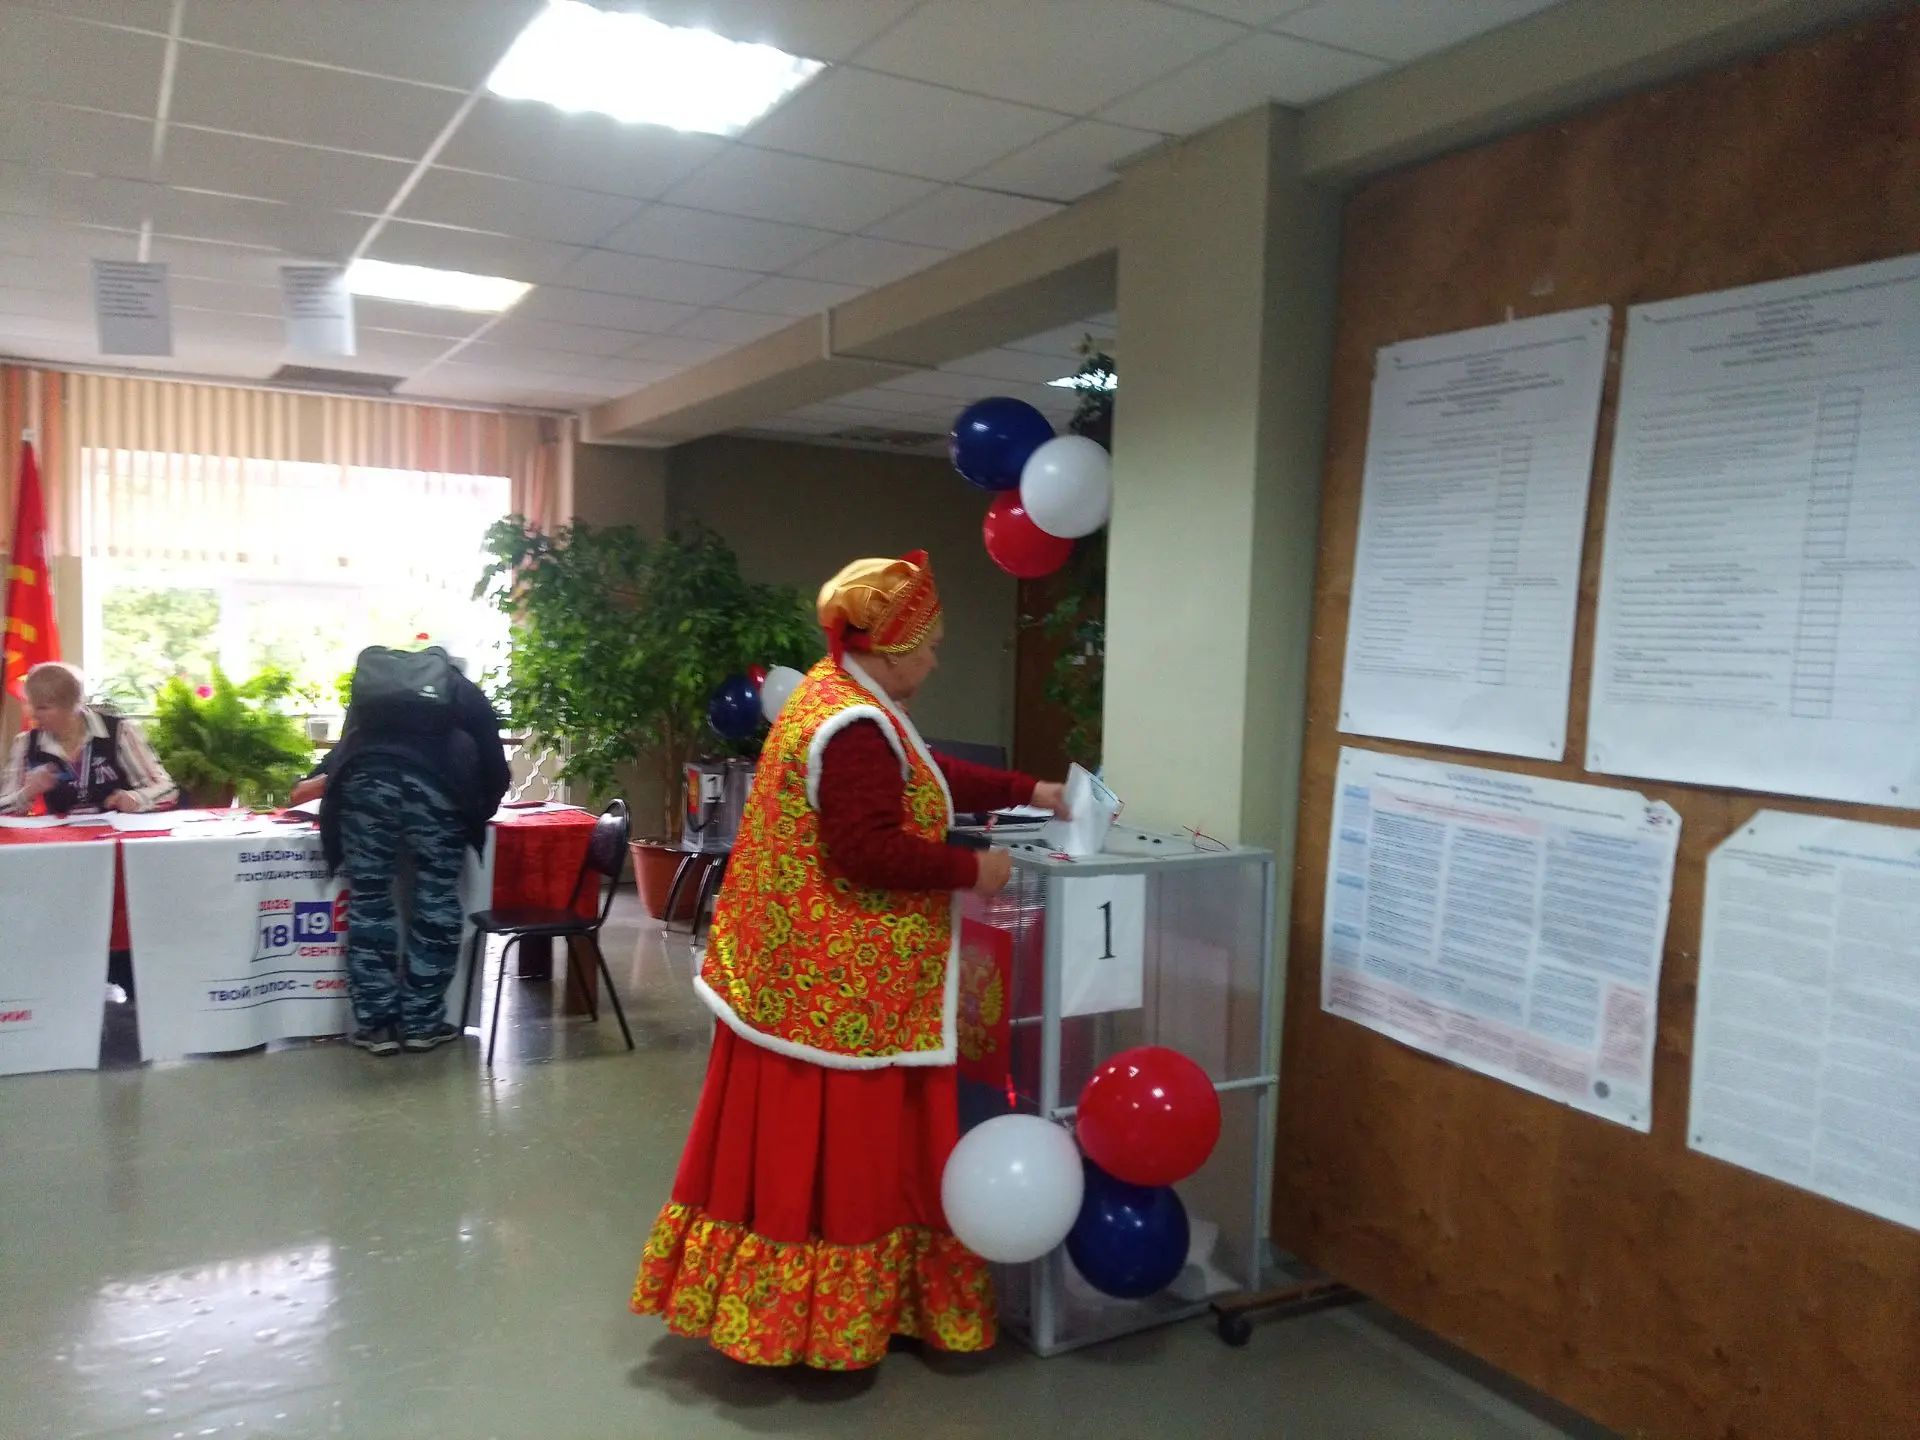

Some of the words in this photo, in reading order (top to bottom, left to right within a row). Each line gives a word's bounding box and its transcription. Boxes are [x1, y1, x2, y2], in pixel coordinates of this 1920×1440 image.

[239, 850, 307, 863] ВЫБОРЫ
[262, 925, 288, 949] 18
[295, 911, 330, 935] 19
[1097, 901, 1117, 960] 1
[208, 986, 251, 1001] ТВОЙ
[254, 980, 297, 995] ГОЛОС
[313, 979, 347, 991] СИЛ
